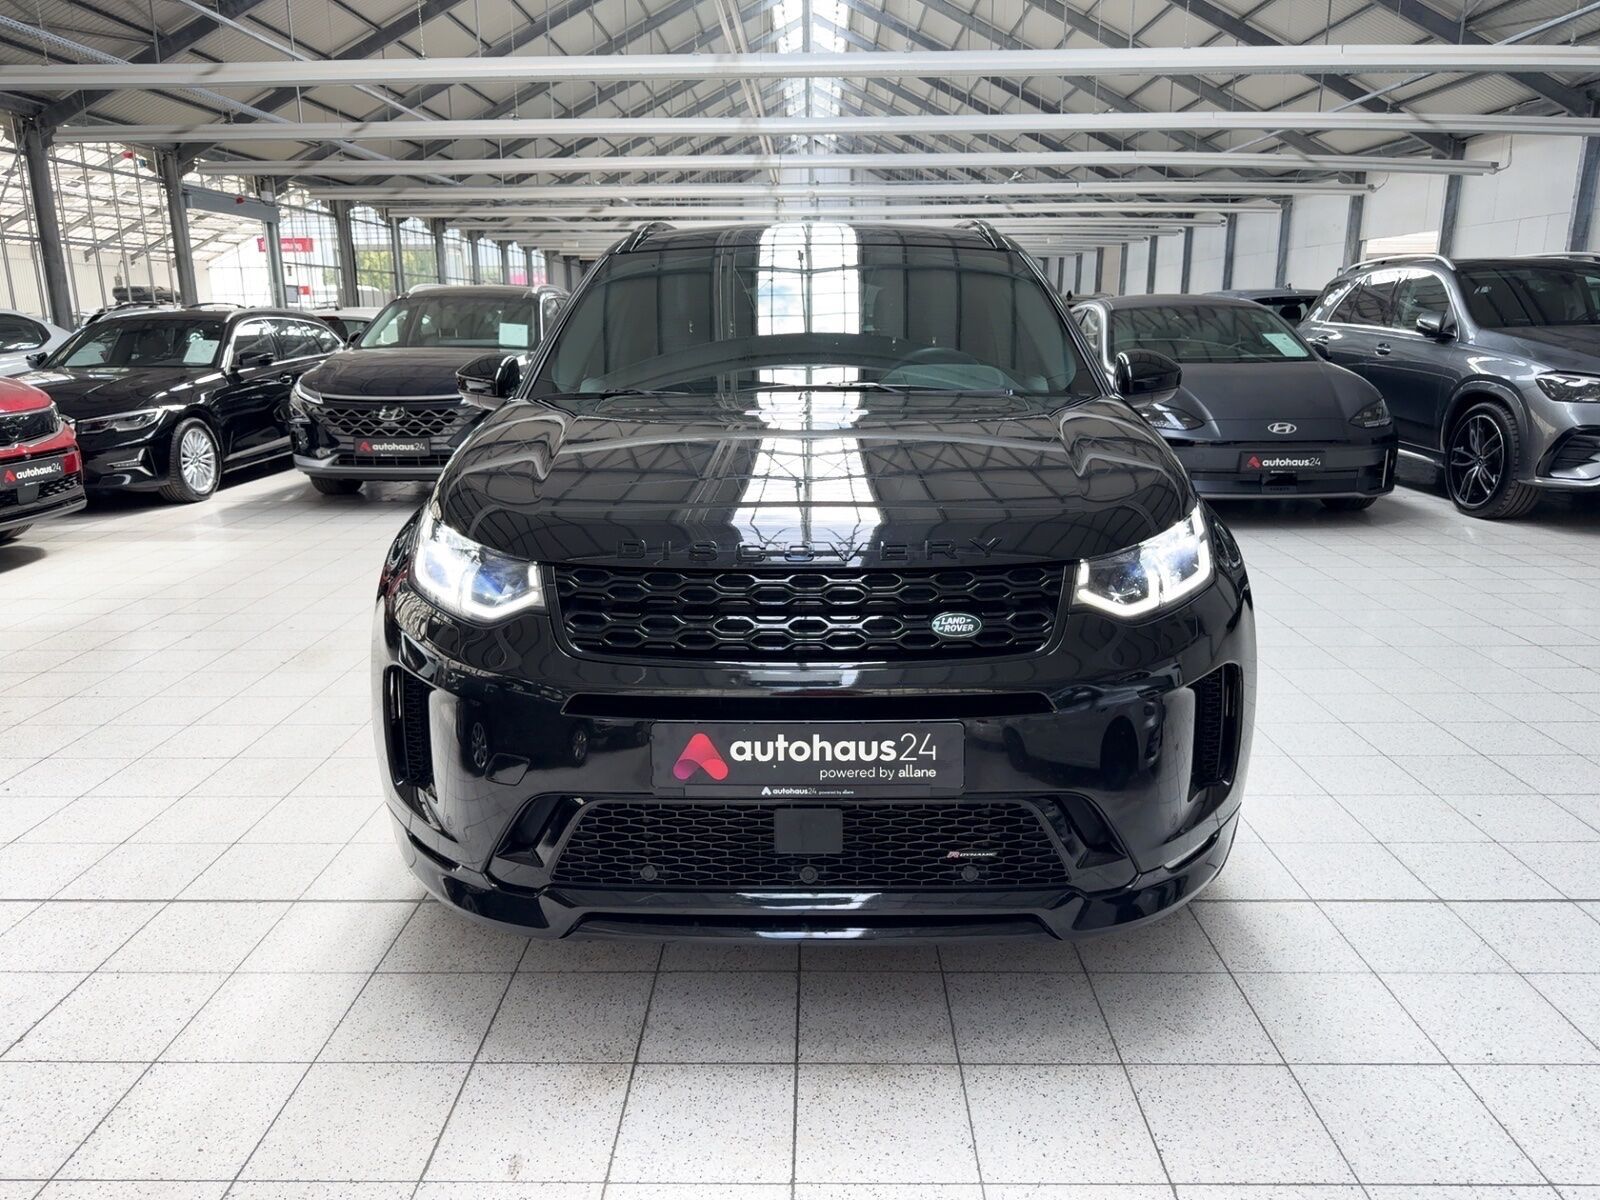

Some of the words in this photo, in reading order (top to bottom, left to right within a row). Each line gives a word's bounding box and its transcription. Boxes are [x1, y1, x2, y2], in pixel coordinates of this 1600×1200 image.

[372, 442, 426, 451] autohaus24
[1262, 457, 1321, 466] autohaus24
[16, 462, 62, 480] autohaus24
[617, 538, 1001, 561] DISCOVERY
[729, 732, 937, 762] autohaus24
[819, 767, 876, 781] powered
[879, 766, 896, 781] by
[898, 765, 937, 778] allane
[772, 787, 817, 795] autohaus24
